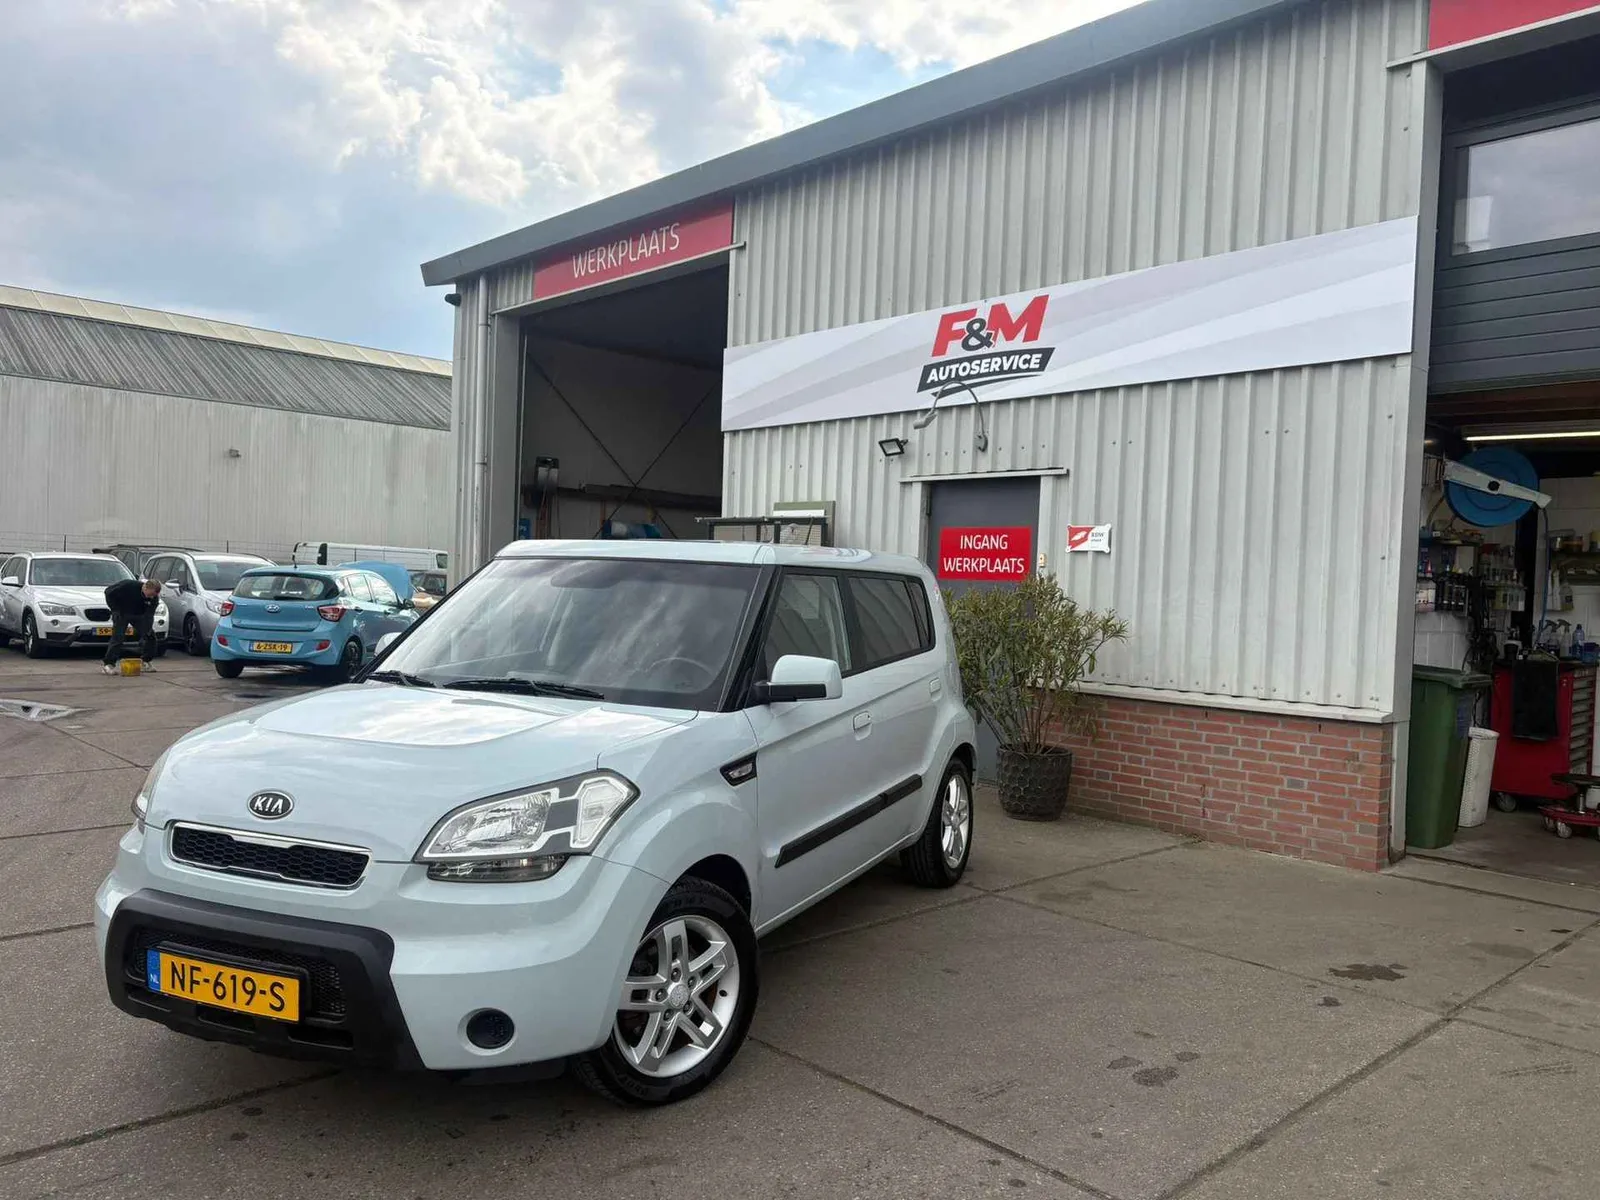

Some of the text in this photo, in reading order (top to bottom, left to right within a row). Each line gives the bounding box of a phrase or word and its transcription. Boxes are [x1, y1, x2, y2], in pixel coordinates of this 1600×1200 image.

[572, 222, 680, 278] WERKPLAATS
[931, 294, 1050, 358] F&M
[926, 353, 1043, 384] AUTOSERVICE
[960, 534, 1009, 551] INGANG
[943, 556, 1025, 575] WERKPLAATS
[253, 796, 284, 814] KIA
[150, 959, 286, 1013] NL NF-619-S
